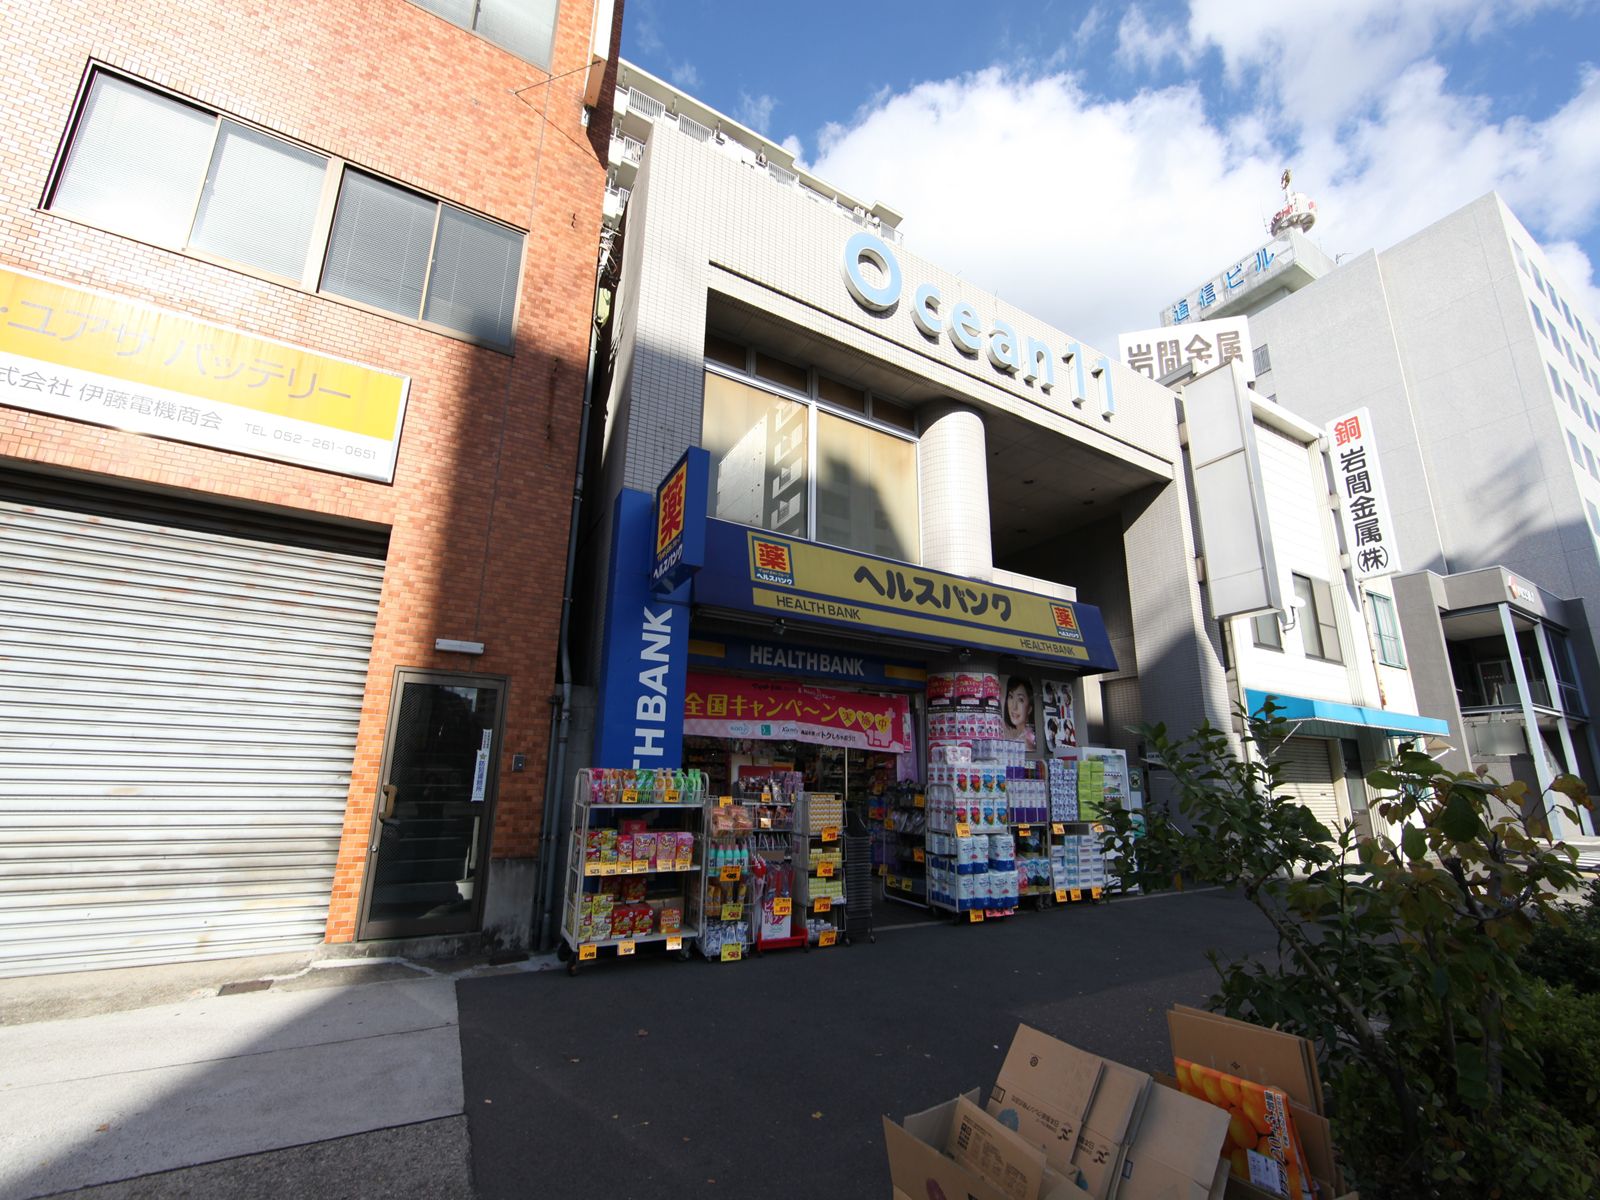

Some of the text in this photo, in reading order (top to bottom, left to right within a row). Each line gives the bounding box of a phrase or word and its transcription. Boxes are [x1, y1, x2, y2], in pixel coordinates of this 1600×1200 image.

[1172, 248, 1275, 325] 通信ビル
[79, 383, 223, 430] 伊藤電機商会
[244, 422, 377, 460] TEL 052-261-0651
[1333, 415, 1362, 447] 銅
[660, 471, 685, 546] 薬
[757, 540, 789, 571] 薬
[756, 572, 793, 586] ヘルスバンク
[854, 565, 1012, 622] ヘルスバンク
[776, 595, 861, 620] HEALTH BANK
[1054, 606, 1074, 628] 薬
[750, 645, 865, 676] HEALTH BANK
[1019, 638, 1076, 656] HEALTH BANK
[635, 606, 673, 722] BANK
